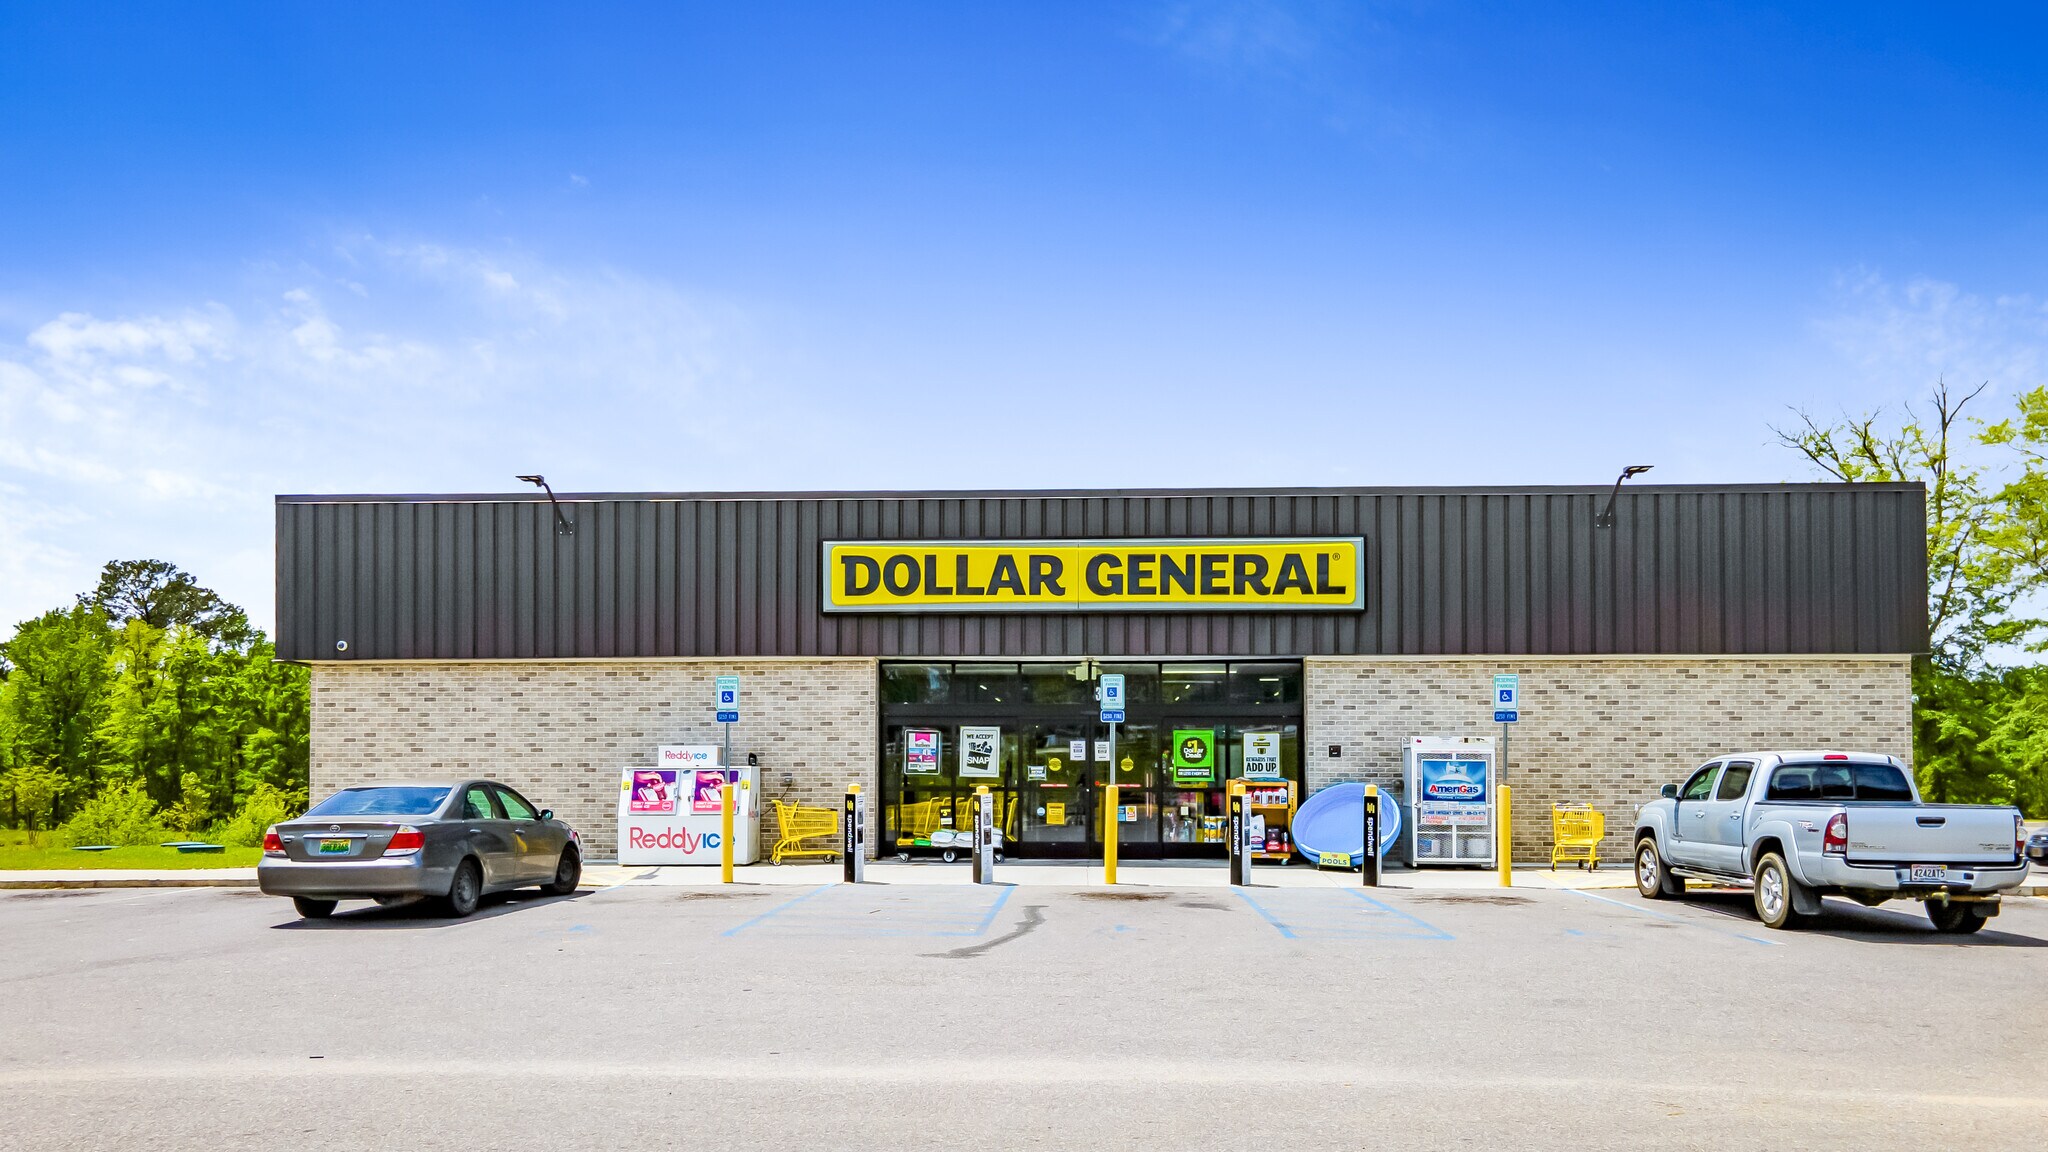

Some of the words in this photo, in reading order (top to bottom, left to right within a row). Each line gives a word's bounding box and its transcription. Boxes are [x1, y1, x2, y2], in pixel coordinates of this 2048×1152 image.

[841, 554, 1066, 596] DOLLAR
[967, 756, 990, 764] SNAP
[1246, 762, 1264, 772] ADD
[1429, 784, 1479, 793] AmeriGas
[1367, 816, 1375, 857] spendwell
[1913, 869, 1945, 878] 4242AT5
